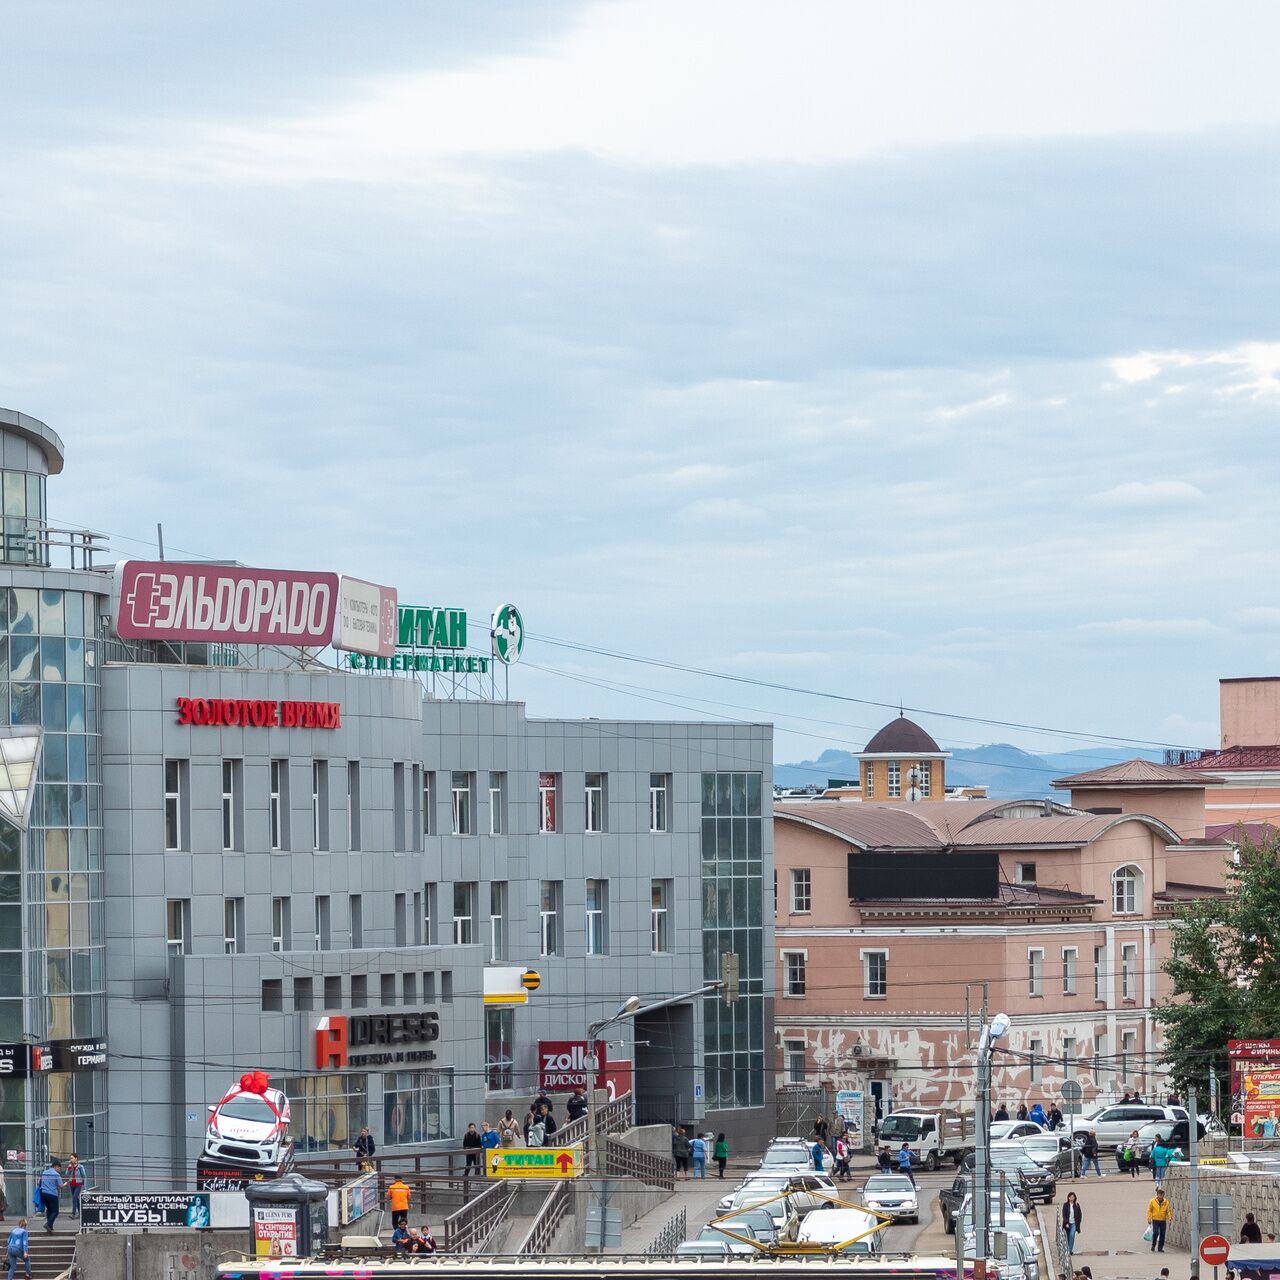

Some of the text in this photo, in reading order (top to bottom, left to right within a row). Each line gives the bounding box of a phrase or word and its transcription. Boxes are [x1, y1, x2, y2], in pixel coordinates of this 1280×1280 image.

[397, 606, 467, 650] ИТАН
[351, 652, 490, 673] СУПЕРМАРКЕТ
[176, 697, 341, 729] ЗОЛОТОЕ ВРЕМЯ
[504, 1153, 555, 1167] ТИТАН
[92, 1195, 195, 1203] ЧЁРНЫЙ БРИЛЛИАНТ
[99, 1209, 167, 1223] ШУБЫ
[258, 1230, 294, 1239] ОТКРЫТИЕ
